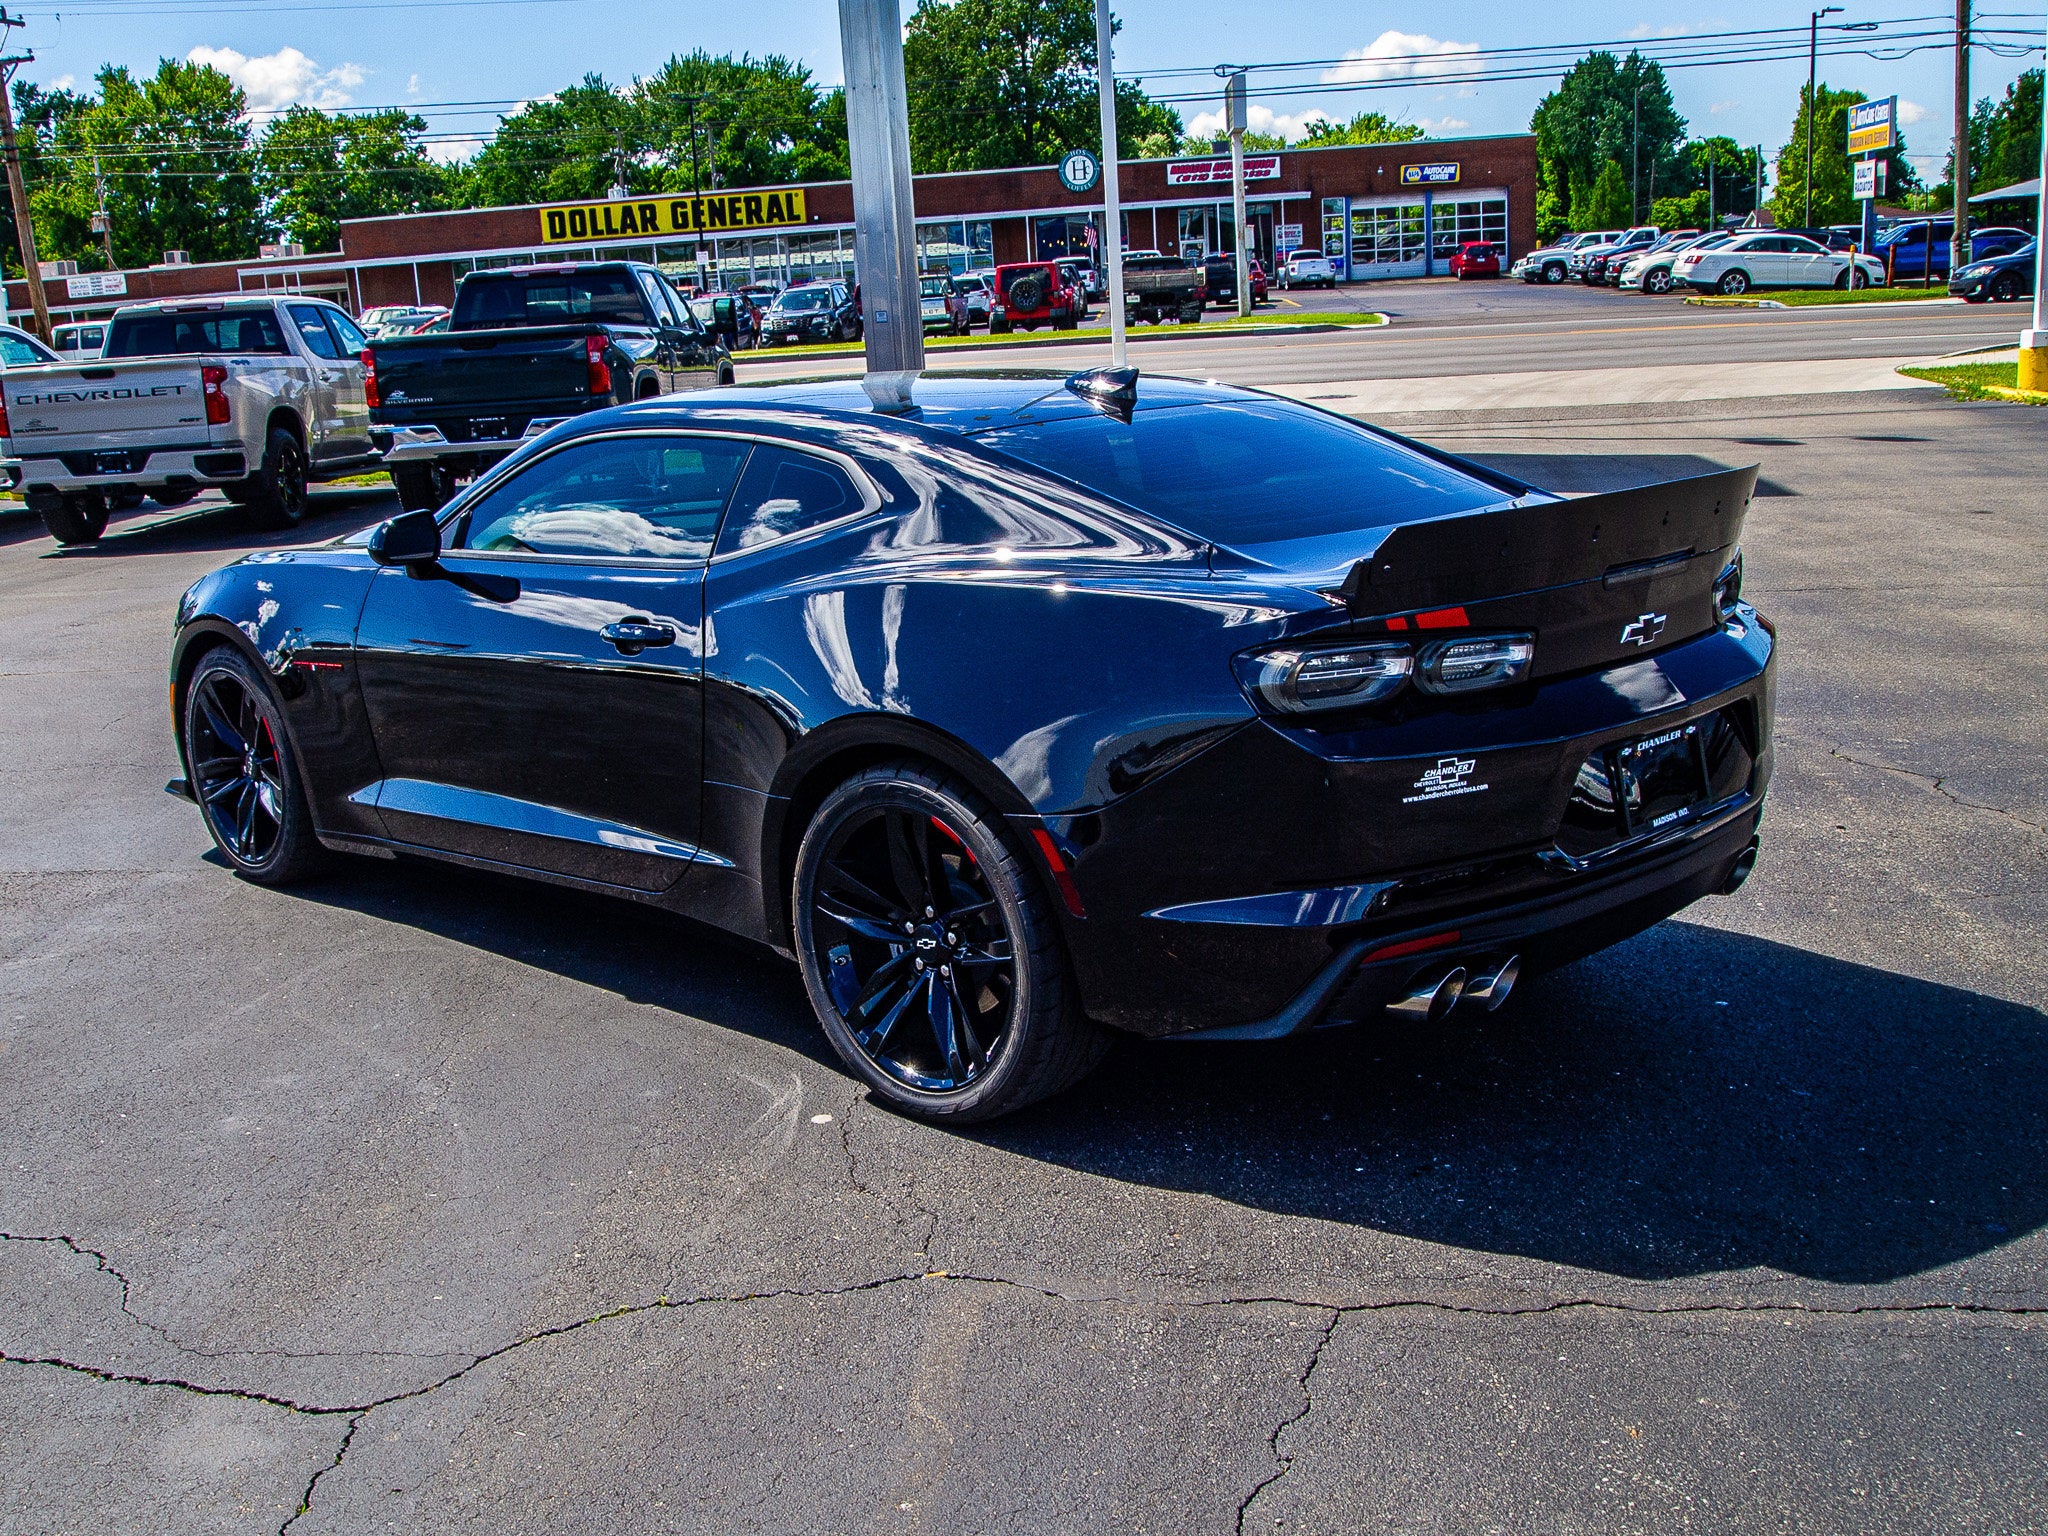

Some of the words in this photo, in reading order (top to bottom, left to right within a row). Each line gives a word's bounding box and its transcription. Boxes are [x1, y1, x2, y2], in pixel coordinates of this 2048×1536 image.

[1170, 163, 1213, 175] MADISON
[1243, 158, 1277, 170] ERVICE
[1857, 168, 1872, 179] QUALITY
[1067, 182, 1092, 192] COFFEE
[1855, 181, 1872, 192] RADIATOR
[547, 203, 660, 240] DOLLAR
[670, 193, 801, 230] GENERAL
[17, 385, 187, 405] CHEVROLET
[384, 396, 433, 405] SILVERADO
[1637, 729, 1681, 751] CHANDLER
[1424, 764, 1469, 778] CHANDLER
[1414, 779, 1439, 788] CHEVROLET
[1402, 783, 1489, 804] www.chandlerchevroletusa.com
